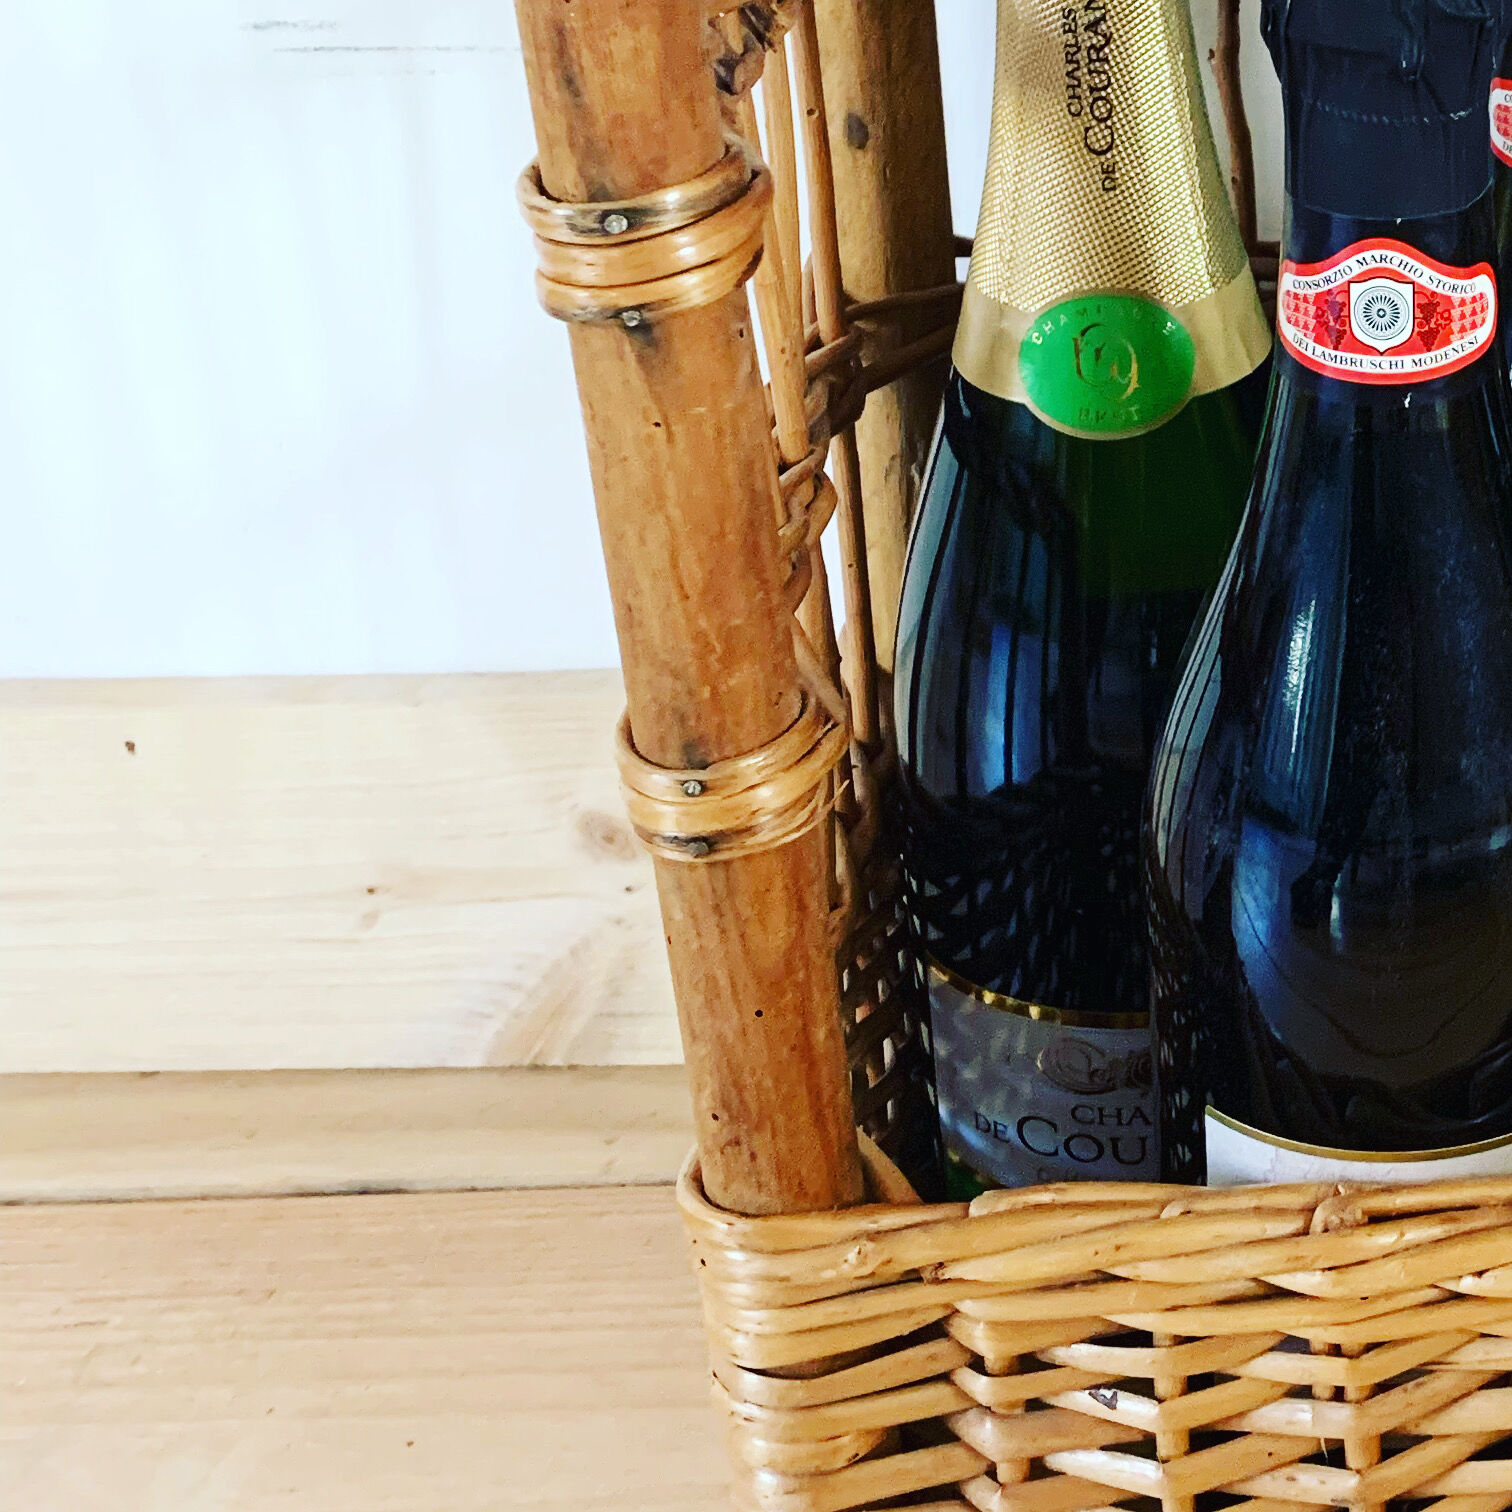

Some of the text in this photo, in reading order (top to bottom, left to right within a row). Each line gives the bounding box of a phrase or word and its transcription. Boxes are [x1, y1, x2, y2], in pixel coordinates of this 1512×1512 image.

[1063, 7, 1083, 117] CHARLES
[1101, 160, 1117, 191] DE
[1292, 252, 1477, 293] CONSORZIO MARCHIO STORICO
[1292, 332, 1479, 370] DEI LAMBRUSCHI MODENESI
[1071, 1104, 1152, 1127] CHA
[974, 1111, 1148, 1165] DE COU
